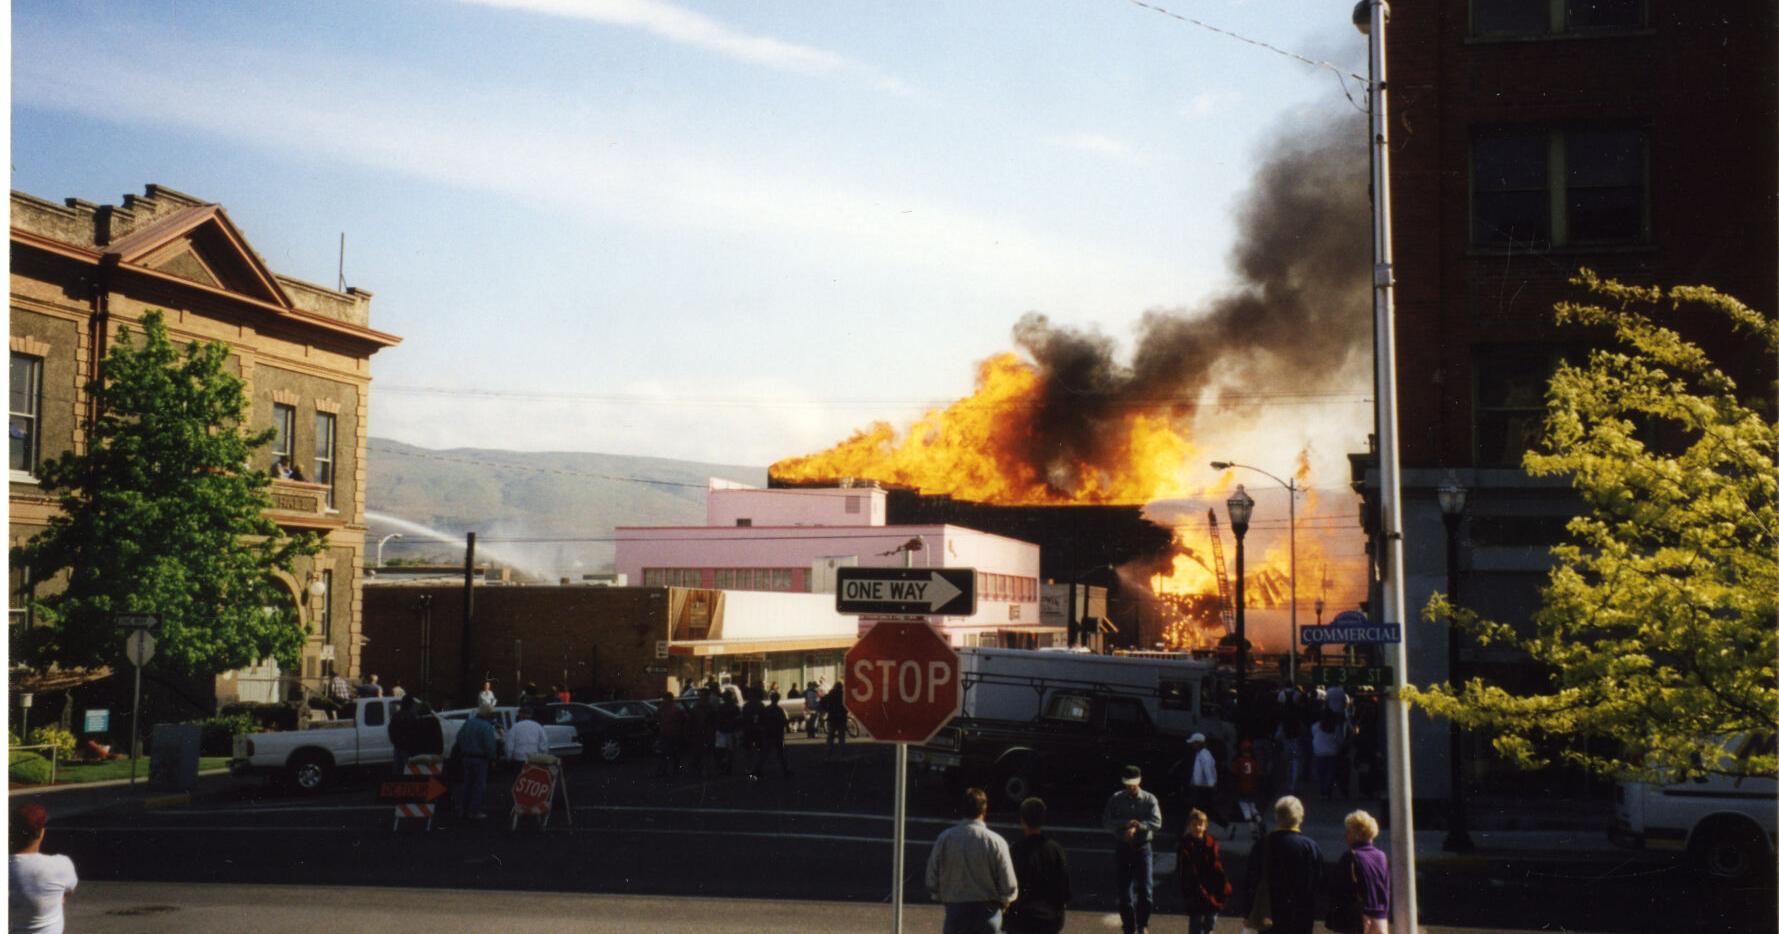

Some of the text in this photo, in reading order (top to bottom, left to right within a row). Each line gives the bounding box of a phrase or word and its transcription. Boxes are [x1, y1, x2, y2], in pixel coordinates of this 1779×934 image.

[847, 581, 928, 601] ONE WAY
[1302, 627, 1399, 642] COMMERCIAL
[851, 659, 951, 703] STOP
[1322, 668, 1329, 682] E
[1367, 668, 1382, 682] ST
[1243, 761, 1252, 775] 3
[515, 777, 550, 798] STOP
